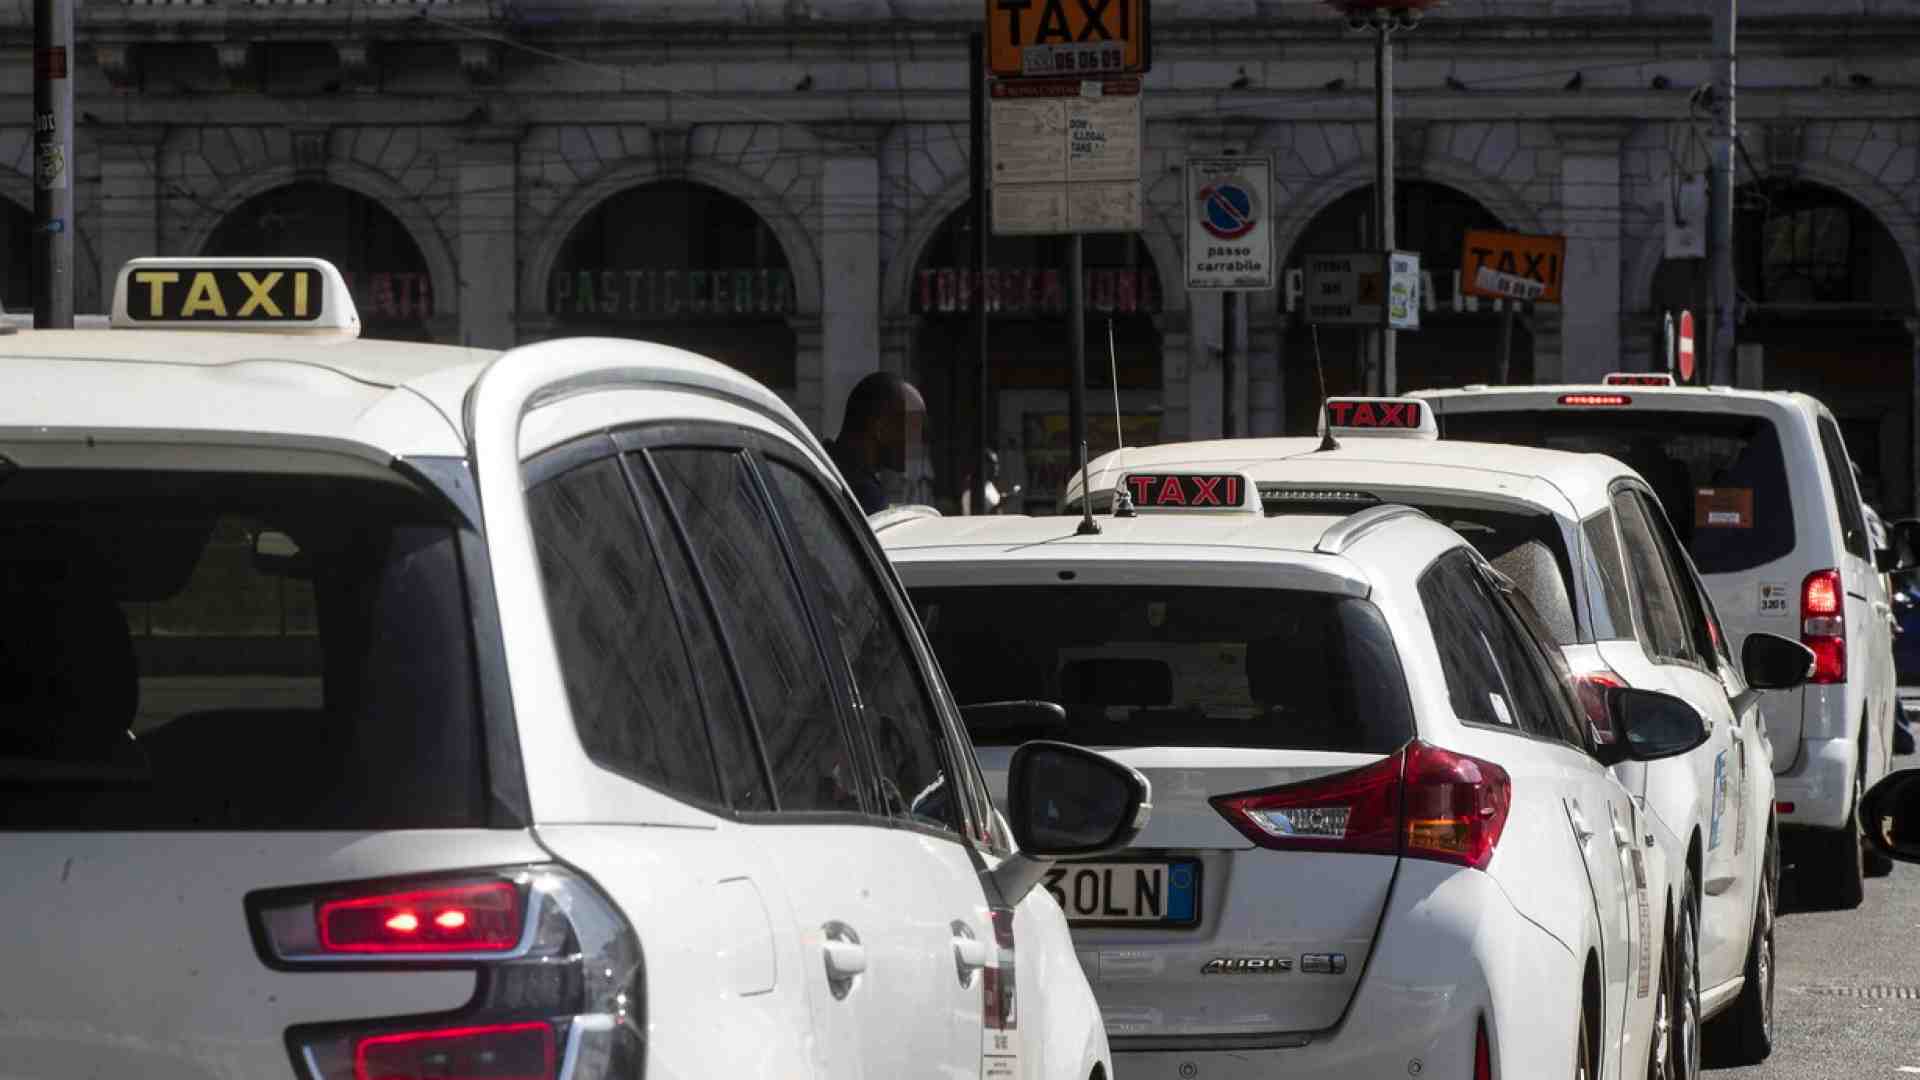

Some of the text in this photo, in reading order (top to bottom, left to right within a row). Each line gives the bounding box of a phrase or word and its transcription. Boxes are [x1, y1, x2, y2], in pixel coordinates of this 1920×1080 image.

[997, 0, 1129, 46] TAXI
[1197, 260, 1262, 272] carrabile
[1207, 246, 1251, 258] passo
[1470, 247, 1557, 285] TAXI
[135, 271, 309, 317] TAXI
[1329, 402, 1417, 427] TAXI
[1128, 476, 1241, 505] TAXI
